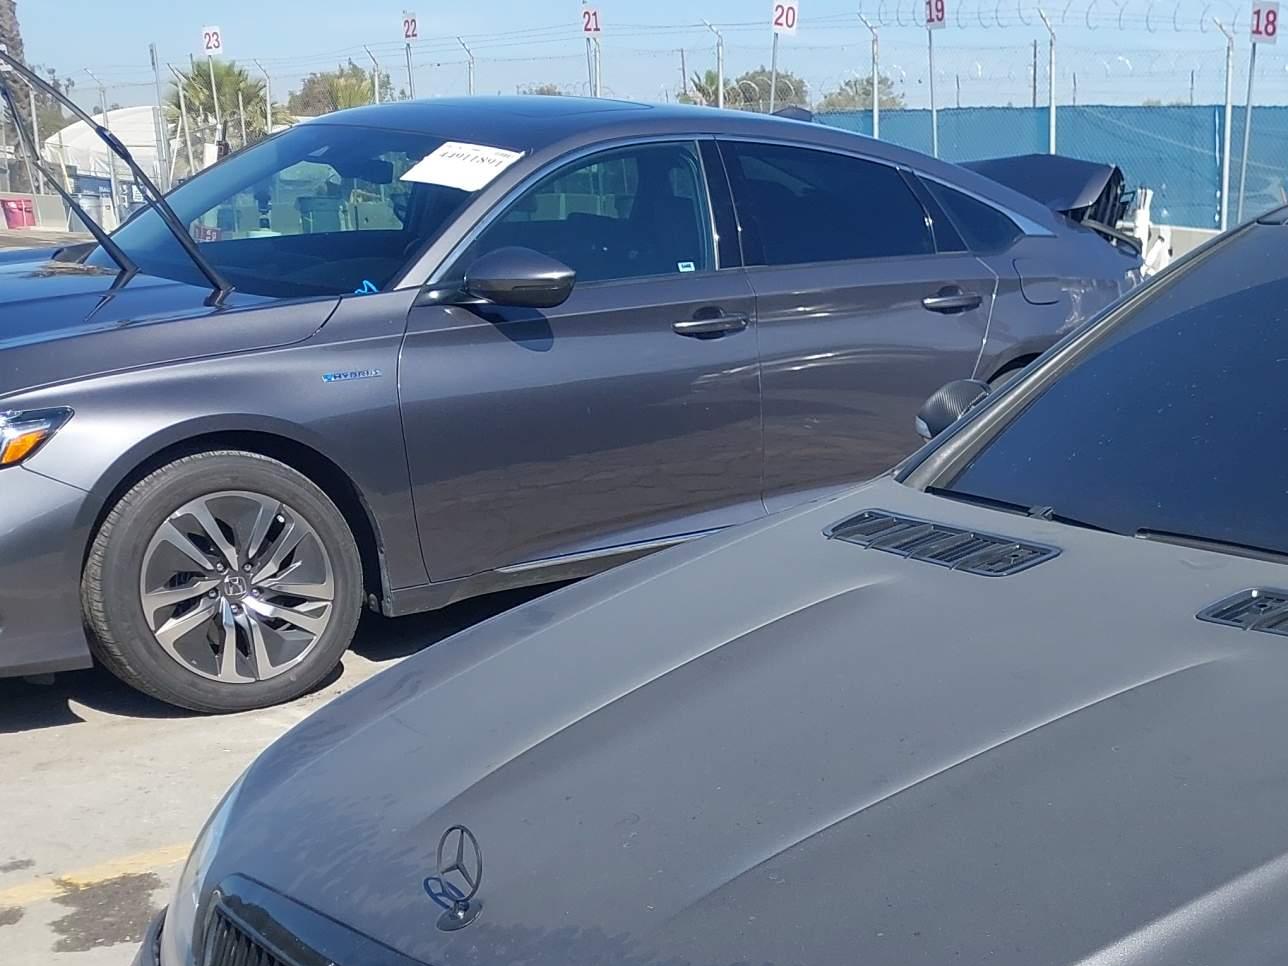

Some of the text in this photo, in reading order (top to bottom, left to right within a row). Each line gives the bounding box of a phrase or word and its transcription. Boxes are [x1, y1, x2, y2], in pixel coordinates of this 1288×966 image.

[582, 11, 600, 32] 21
[774, 4, 796, 28] 20
[926, 0, 945, 22] 19
[403, 18, 418, 38] 22
[1252, 9, 1277, 36] 18
[203, 31, 221, 50] 23
